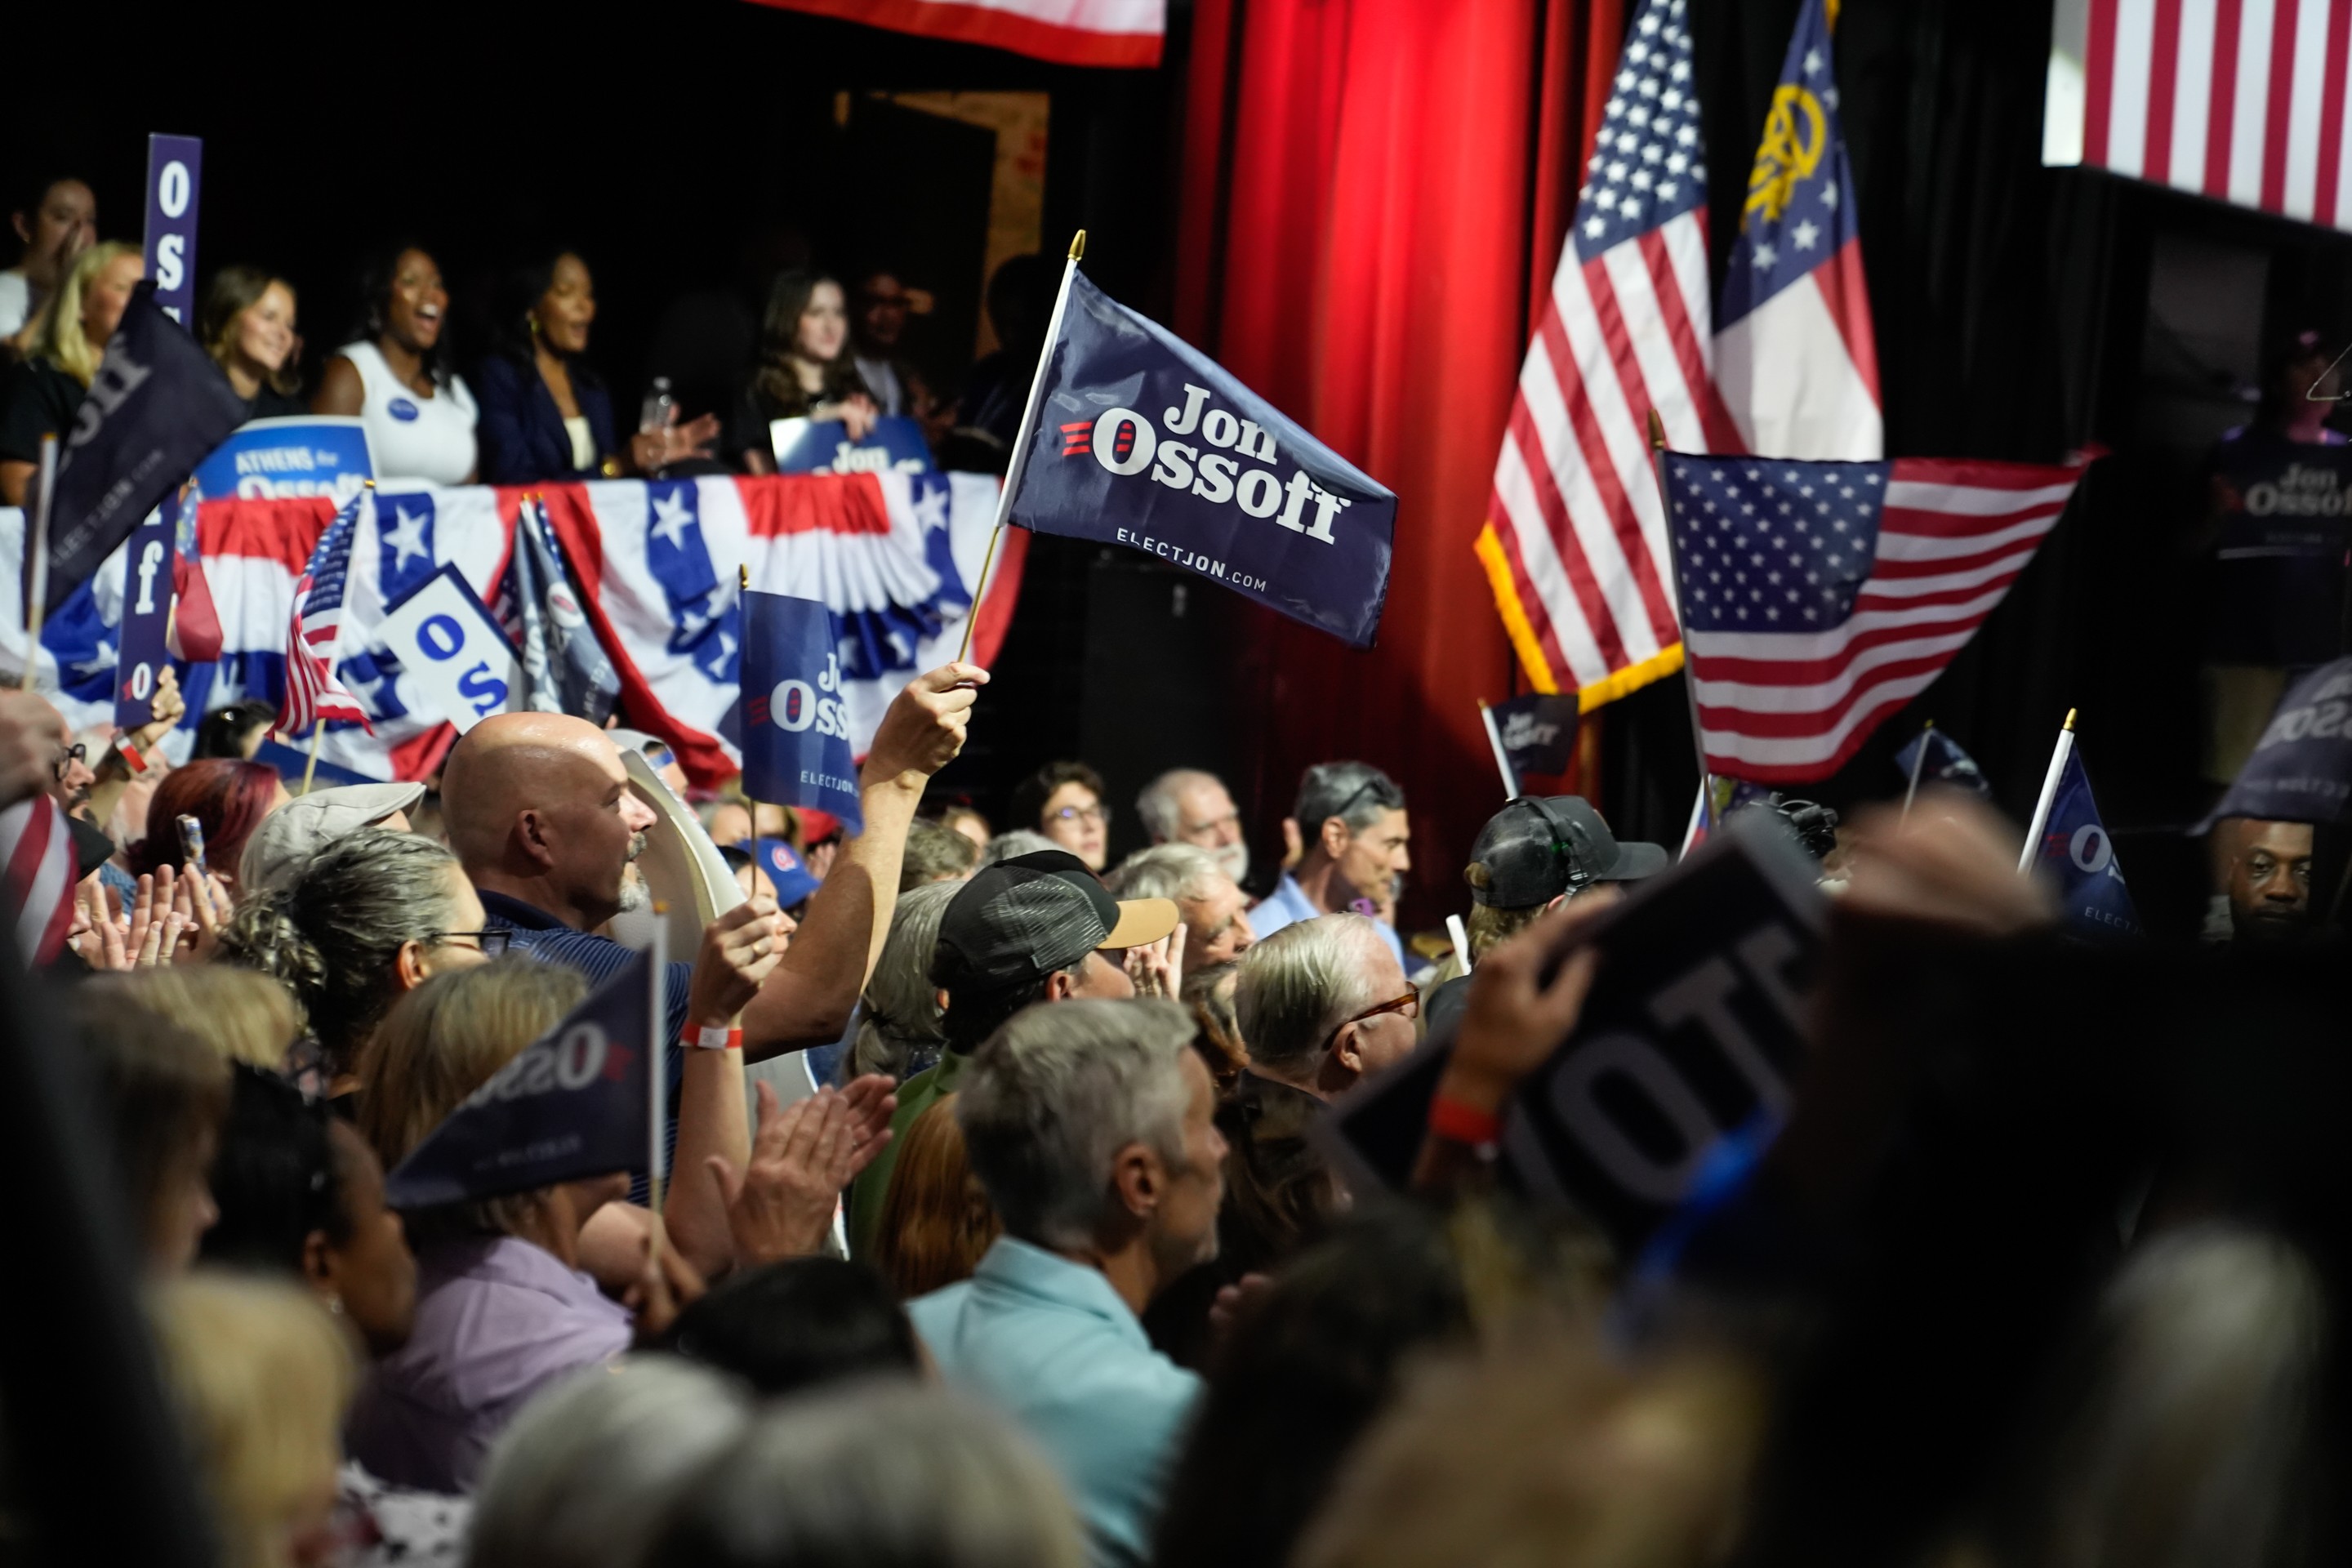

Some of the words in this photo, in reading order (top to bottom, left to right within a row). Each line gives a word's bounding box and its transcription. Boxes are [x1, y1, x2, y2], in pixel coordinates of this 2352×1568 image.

[235, 447, 315, 475] ATHENS
[1163, 382, 1278, 466] Jon
[1092, 407, 1352, 546] Ossoff
[1116, 528, 1267, 592] ELECTJON.COM
